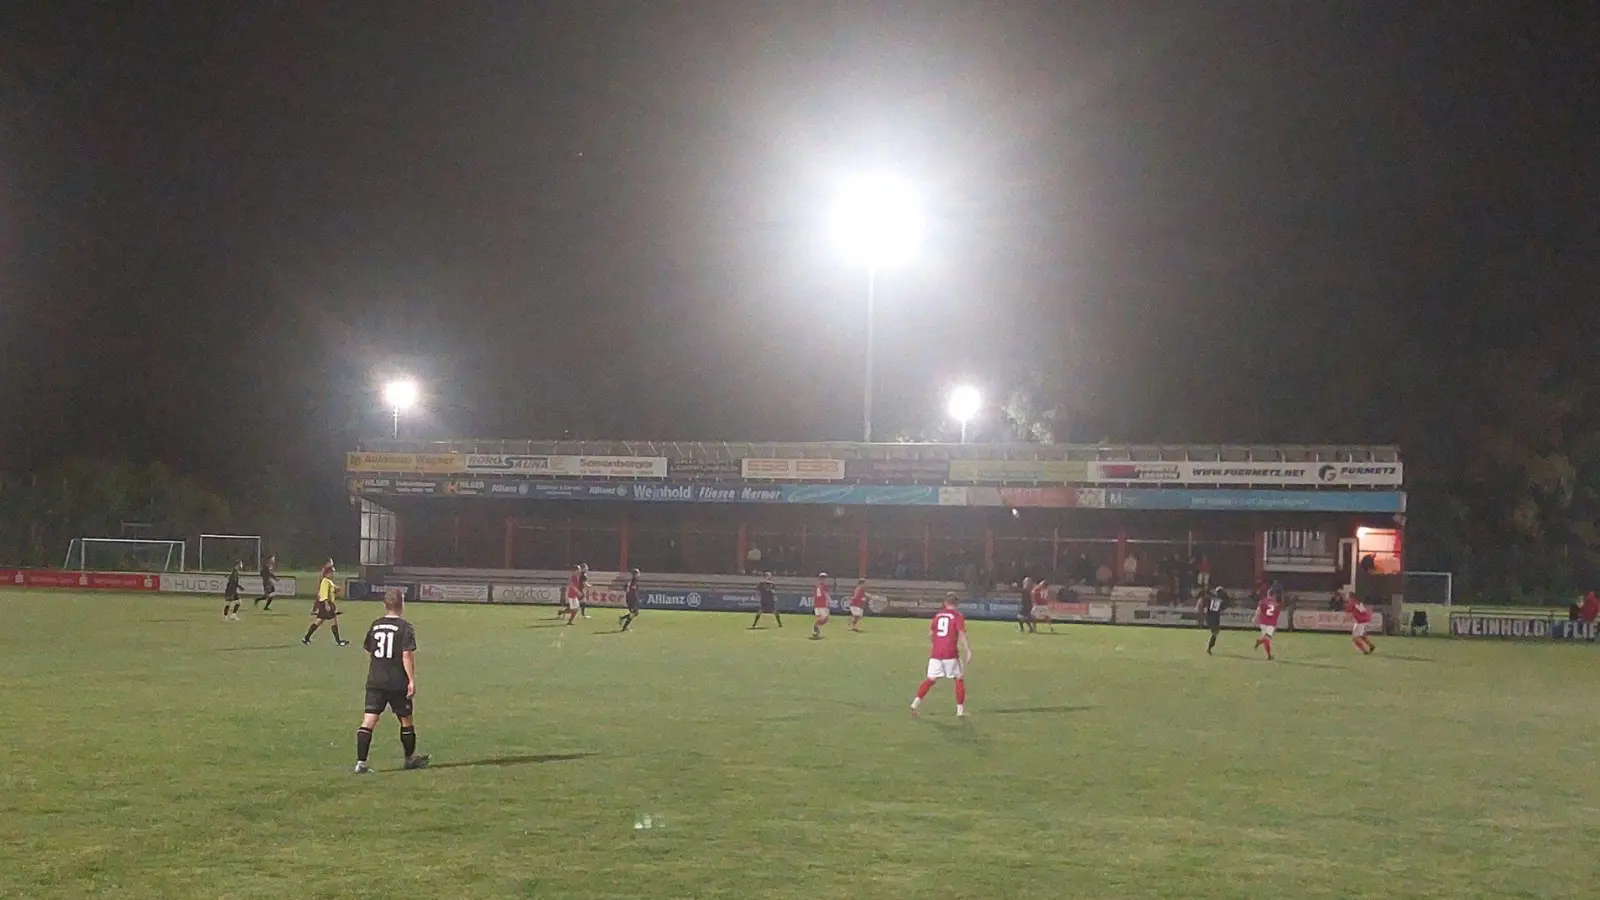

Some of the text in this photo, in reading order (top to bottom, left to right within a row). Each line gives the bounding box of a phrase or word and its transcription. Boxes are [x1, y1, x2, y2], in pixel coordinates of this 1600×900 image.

[588, 486, 615, 494] Allianz
[646, 593, 685, 605] Allianz
[1209, 599, 1221, 612] 19
[1266, 604, 1275, 616] 2
[936, 616, 950, 637] 9
[1455, 618, 1545, 636] WEINHOLD
[373, 631, 395, 659] 31
